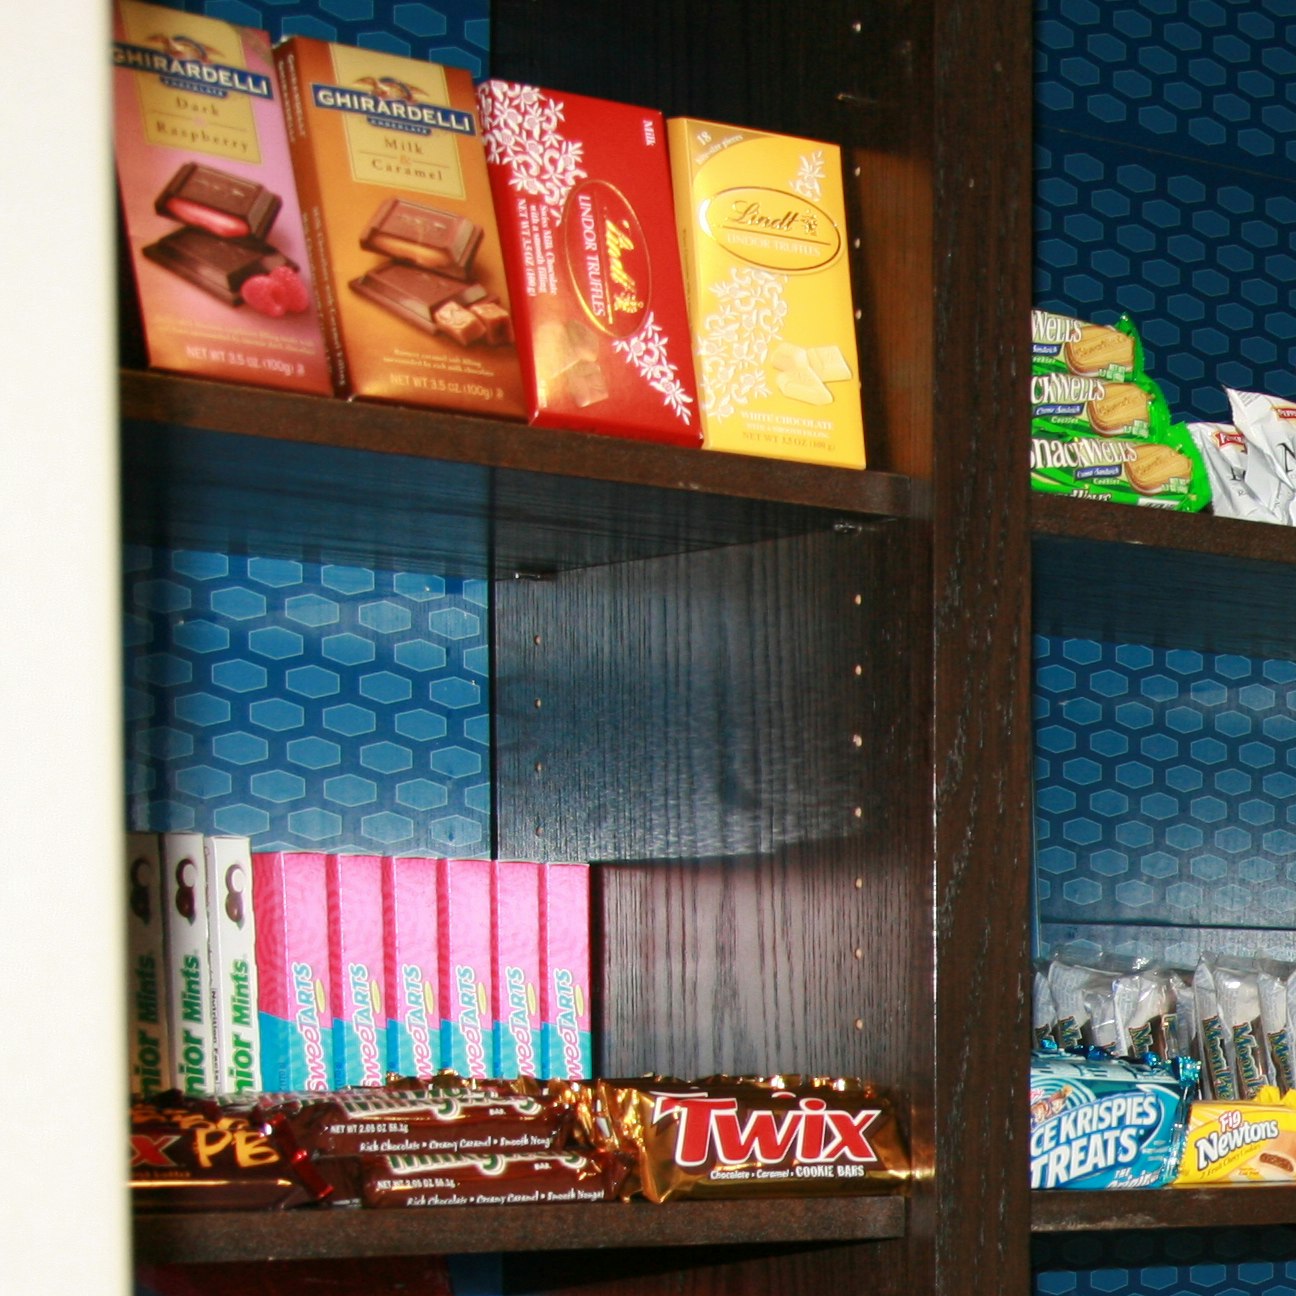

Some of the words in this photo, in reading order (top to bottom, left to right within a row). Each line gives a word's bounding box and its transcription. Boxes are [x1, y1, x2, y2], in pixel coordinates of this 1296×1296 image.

[114, 50, 269, 96] GHIRARDELLI
[176, 96, 219, 116] Dark
[318, 89, 470, 132] GHIRARDELLI
[156, 121, 248, 153] Raspberry
[384, 137, 424, 155] Milk
[643, 119, 656, 147] Milk
[696, 131, 712, 147] 18
[371, 159, 443, 181] Caramel
[578, 194, 598, 251] LINDOR
[724, 199, 800, 231] Lindt
[586, 254, 606, 317] TRUFFLES
[180, 954, 204, 1024] Mints
[230, 958, 253, 1028] Mints
[651, 1097, 882, 1167] Twix
[1059, 1095, 1159, 1144] KRISPIES
[1218, 1110, 1242, 1133] Fig
[195, 1126, 281, 1169] PB
[380, 1140, 421, 1151] Chocolate
[1032, 1127, 1139, 1189] TREATS
[1195, 1119, 1279, 1172] Newtons
[710, 1169, 750, 1180] Chocolate
[756, 1168, 790, 1179] Caramel
[795, 1165, 835, 1178] COOKIE
[837, 1165, 865, 1177] BARS
[427, 1195, 468, 1206] Chocolate
